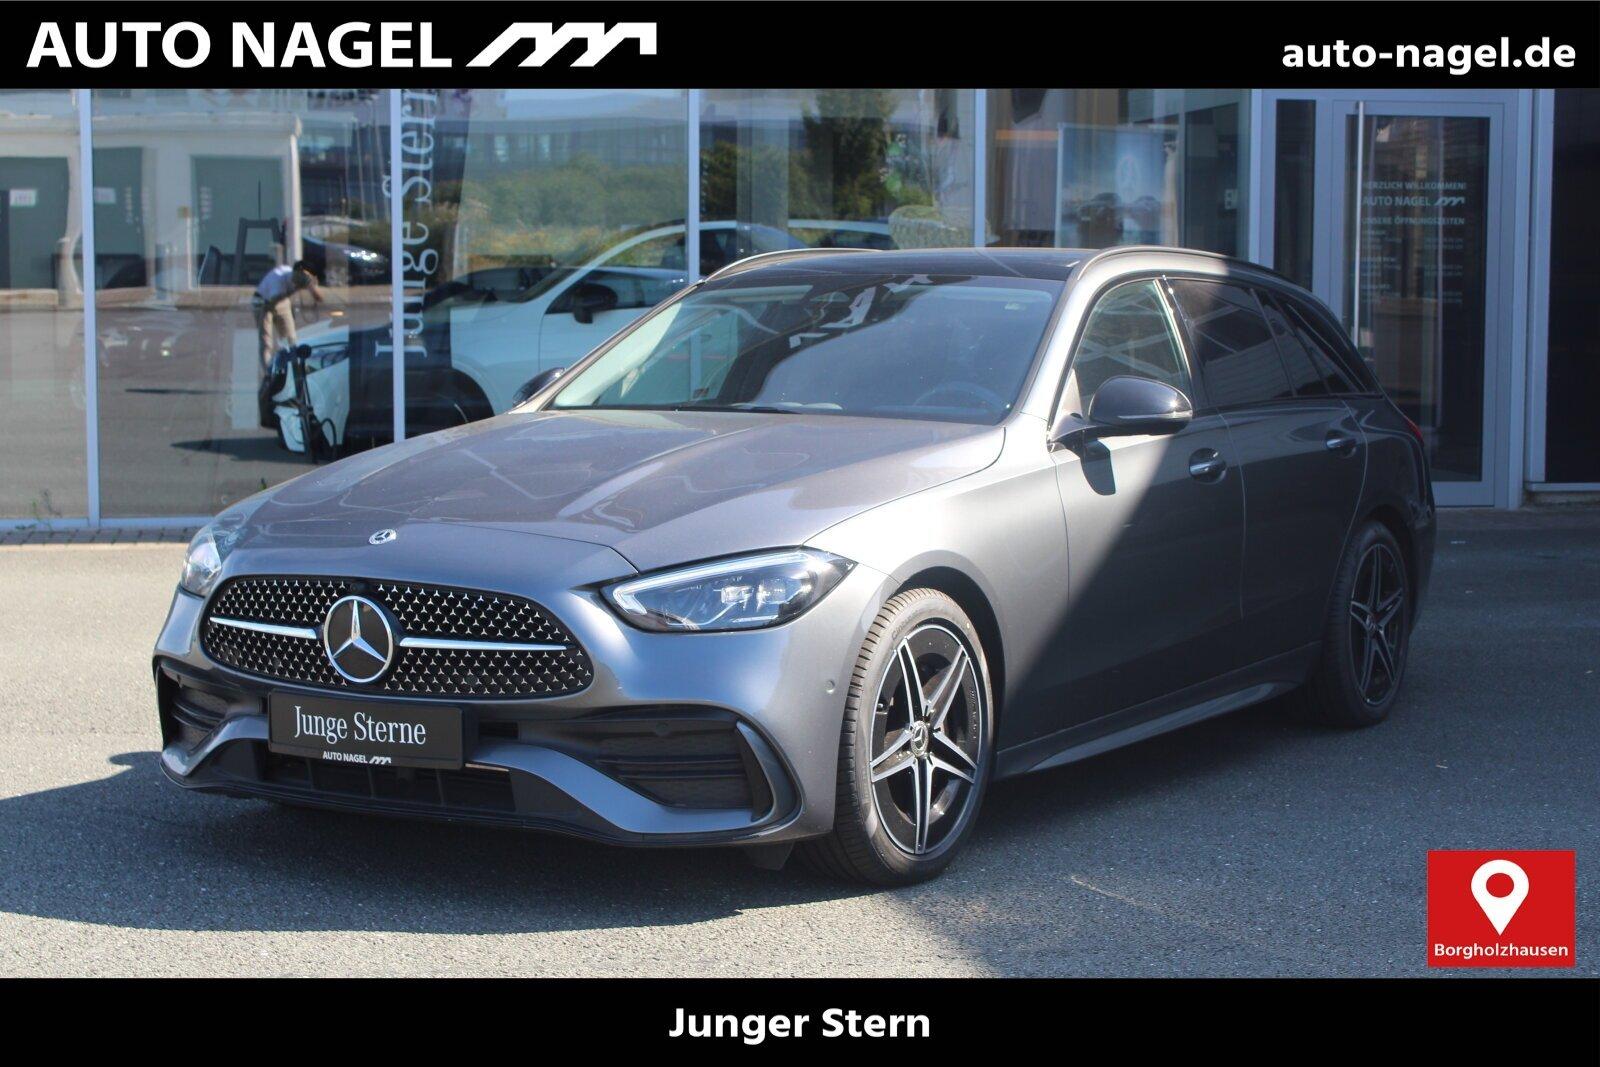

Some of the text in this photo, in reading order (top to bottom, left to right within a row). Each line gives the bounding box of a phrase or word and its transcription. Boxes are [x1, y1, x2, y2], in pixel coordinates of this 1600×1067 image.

[1362, 196, 1431, 206] AUTO NAGEL
[294, 705, 427, 745] Junge Sterne
[322, 751, 368, 764] AUTO NAGEL
